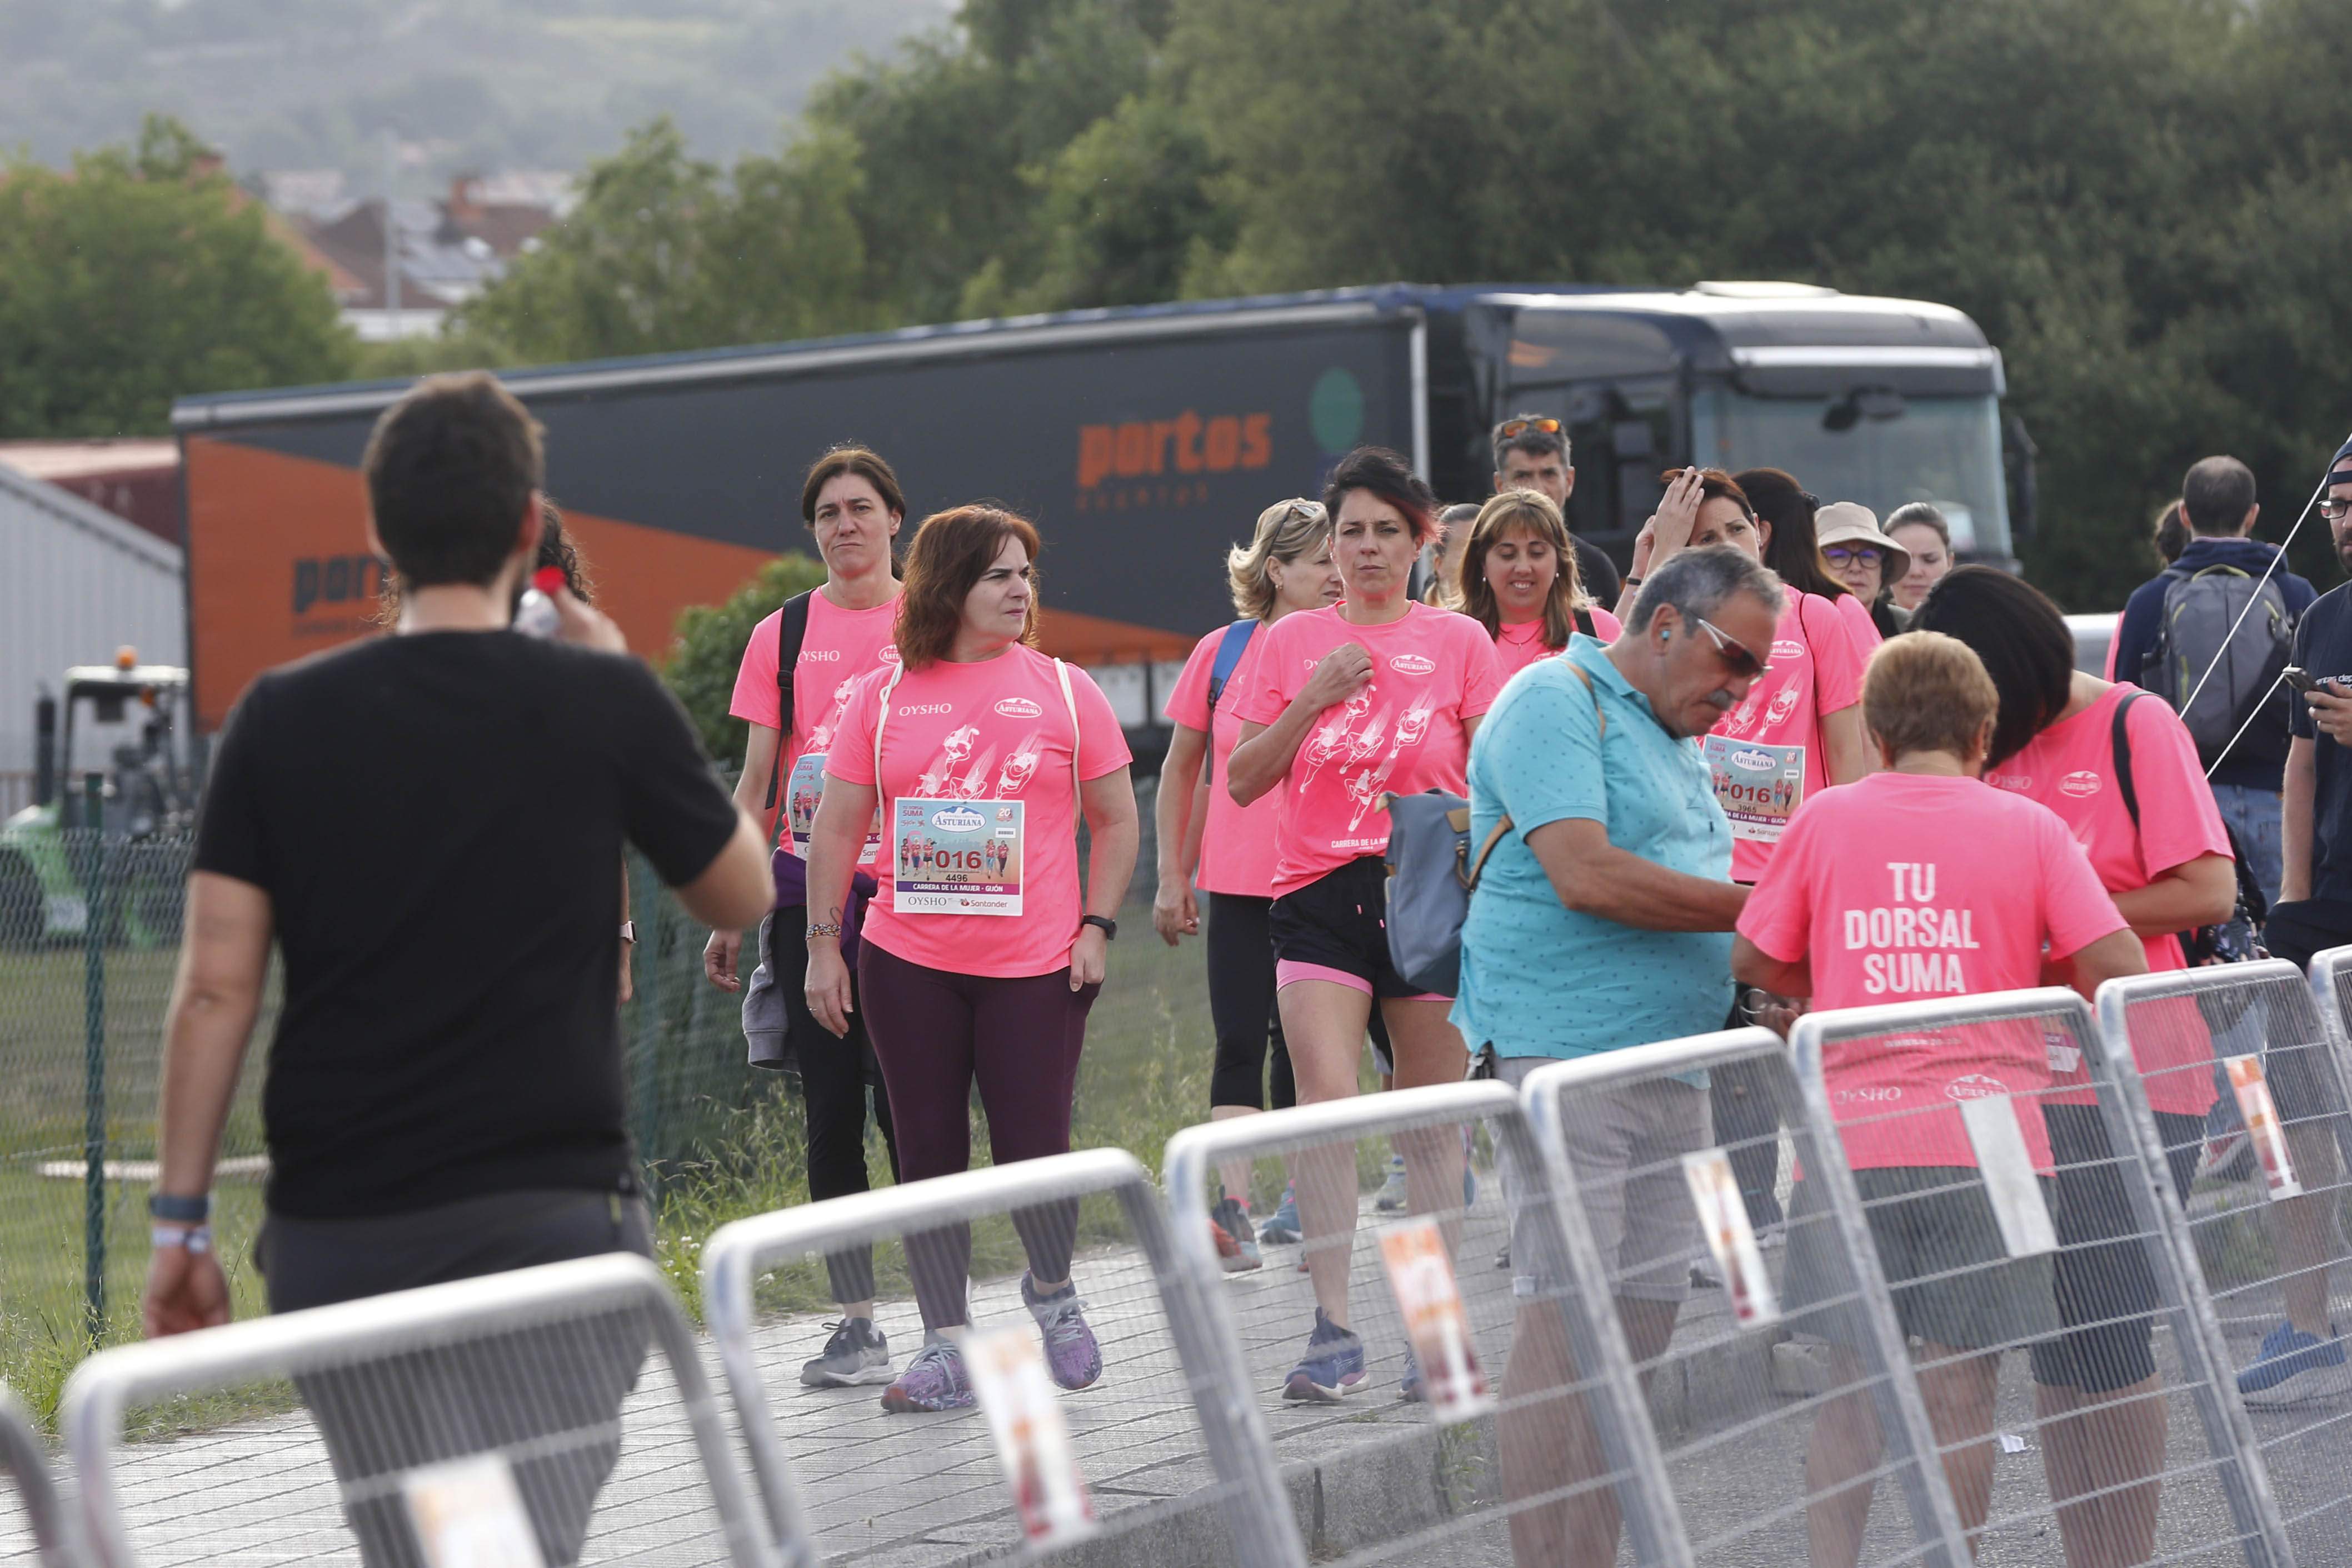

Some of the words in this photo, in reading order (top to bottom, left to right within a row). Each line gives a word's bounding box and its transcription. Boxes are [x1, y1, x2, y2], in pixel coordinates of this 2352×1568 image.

[898, 703, 952, 716] OYSHO
[1734, 753, 1774, 767] ASTURIANA
[1731, 783, 1770, 803] 016
[998, 808, 1011, 816] 20
[935, 815, 982, 826] ASTURIANA
[1331, 839, 1359, 848] CARRERA
[935, 850, 982, 869] 016
[1887, 862, 1935, 902] TU
[908, 897, 947, 906] OYSHO
[1844, 907, 1980, 950] DORSAL
[1863, 953, 1966, 994] SUMA
